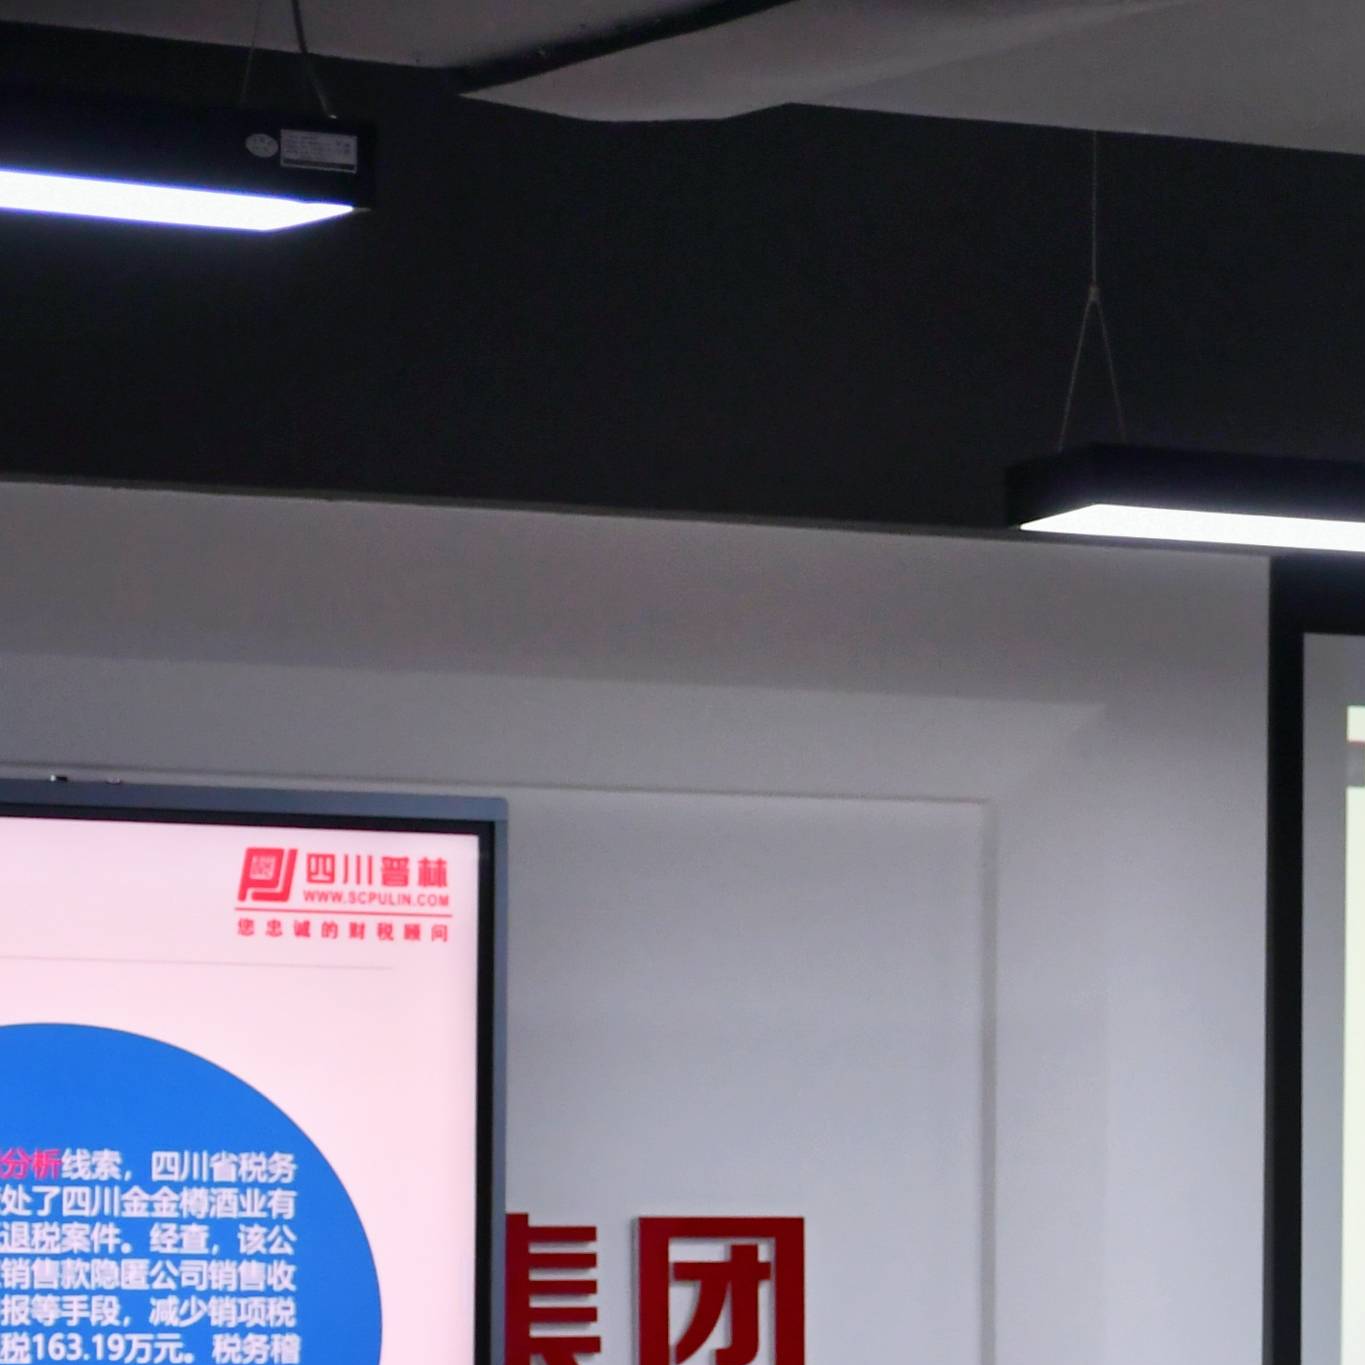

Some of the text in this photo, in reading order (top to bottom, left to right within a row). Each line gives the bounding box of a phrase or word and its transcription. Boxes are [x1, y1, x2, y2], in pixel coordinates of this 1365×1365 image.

[306, 852, 449, 888] 四川普林
[303, 889, 450, 907] WWW.SCPULIN.COM
[237, 917, 450, 943] 您忠诚的财税顾问
